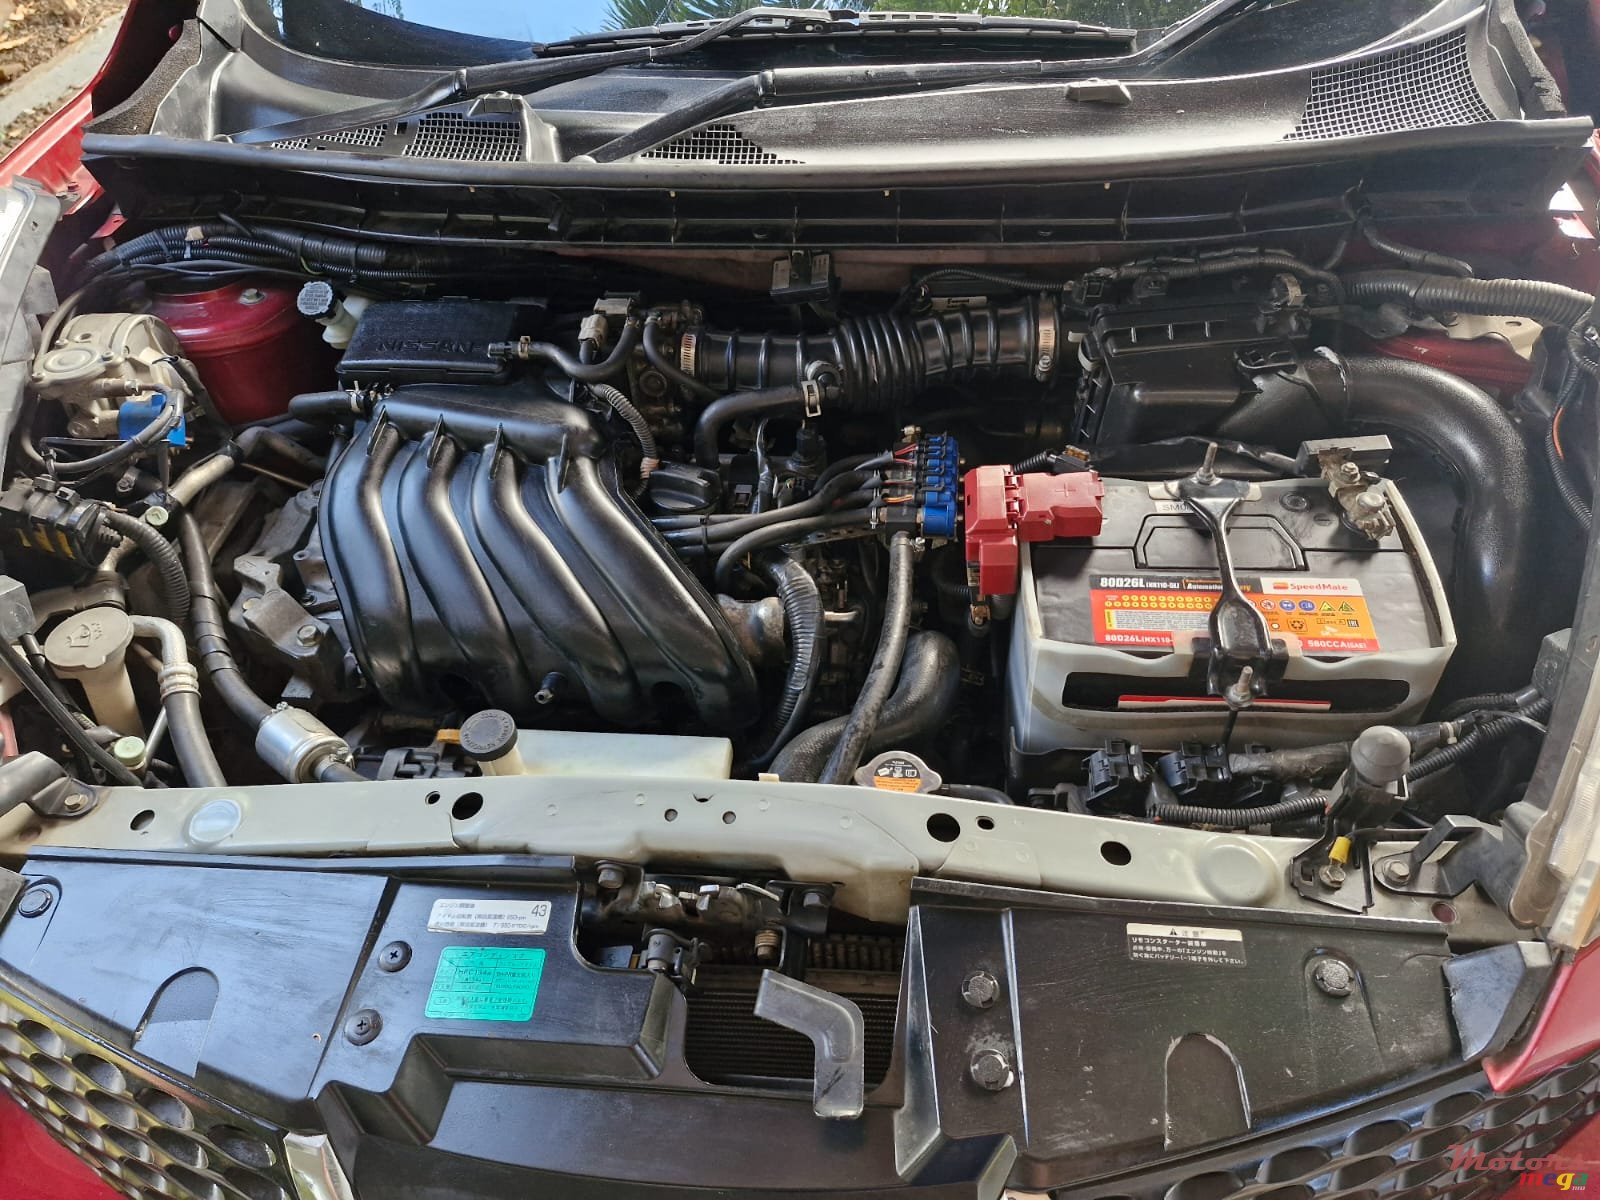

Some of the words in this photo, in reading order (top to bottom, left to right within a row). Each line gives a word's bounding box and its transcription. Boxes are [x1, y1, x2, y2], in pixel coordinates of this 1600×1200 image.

[1100, 577, 1145, 588] 80D26L
[1290, 583, 1348, 591] SpeedMate
[531, 904, 548, 917] 43
